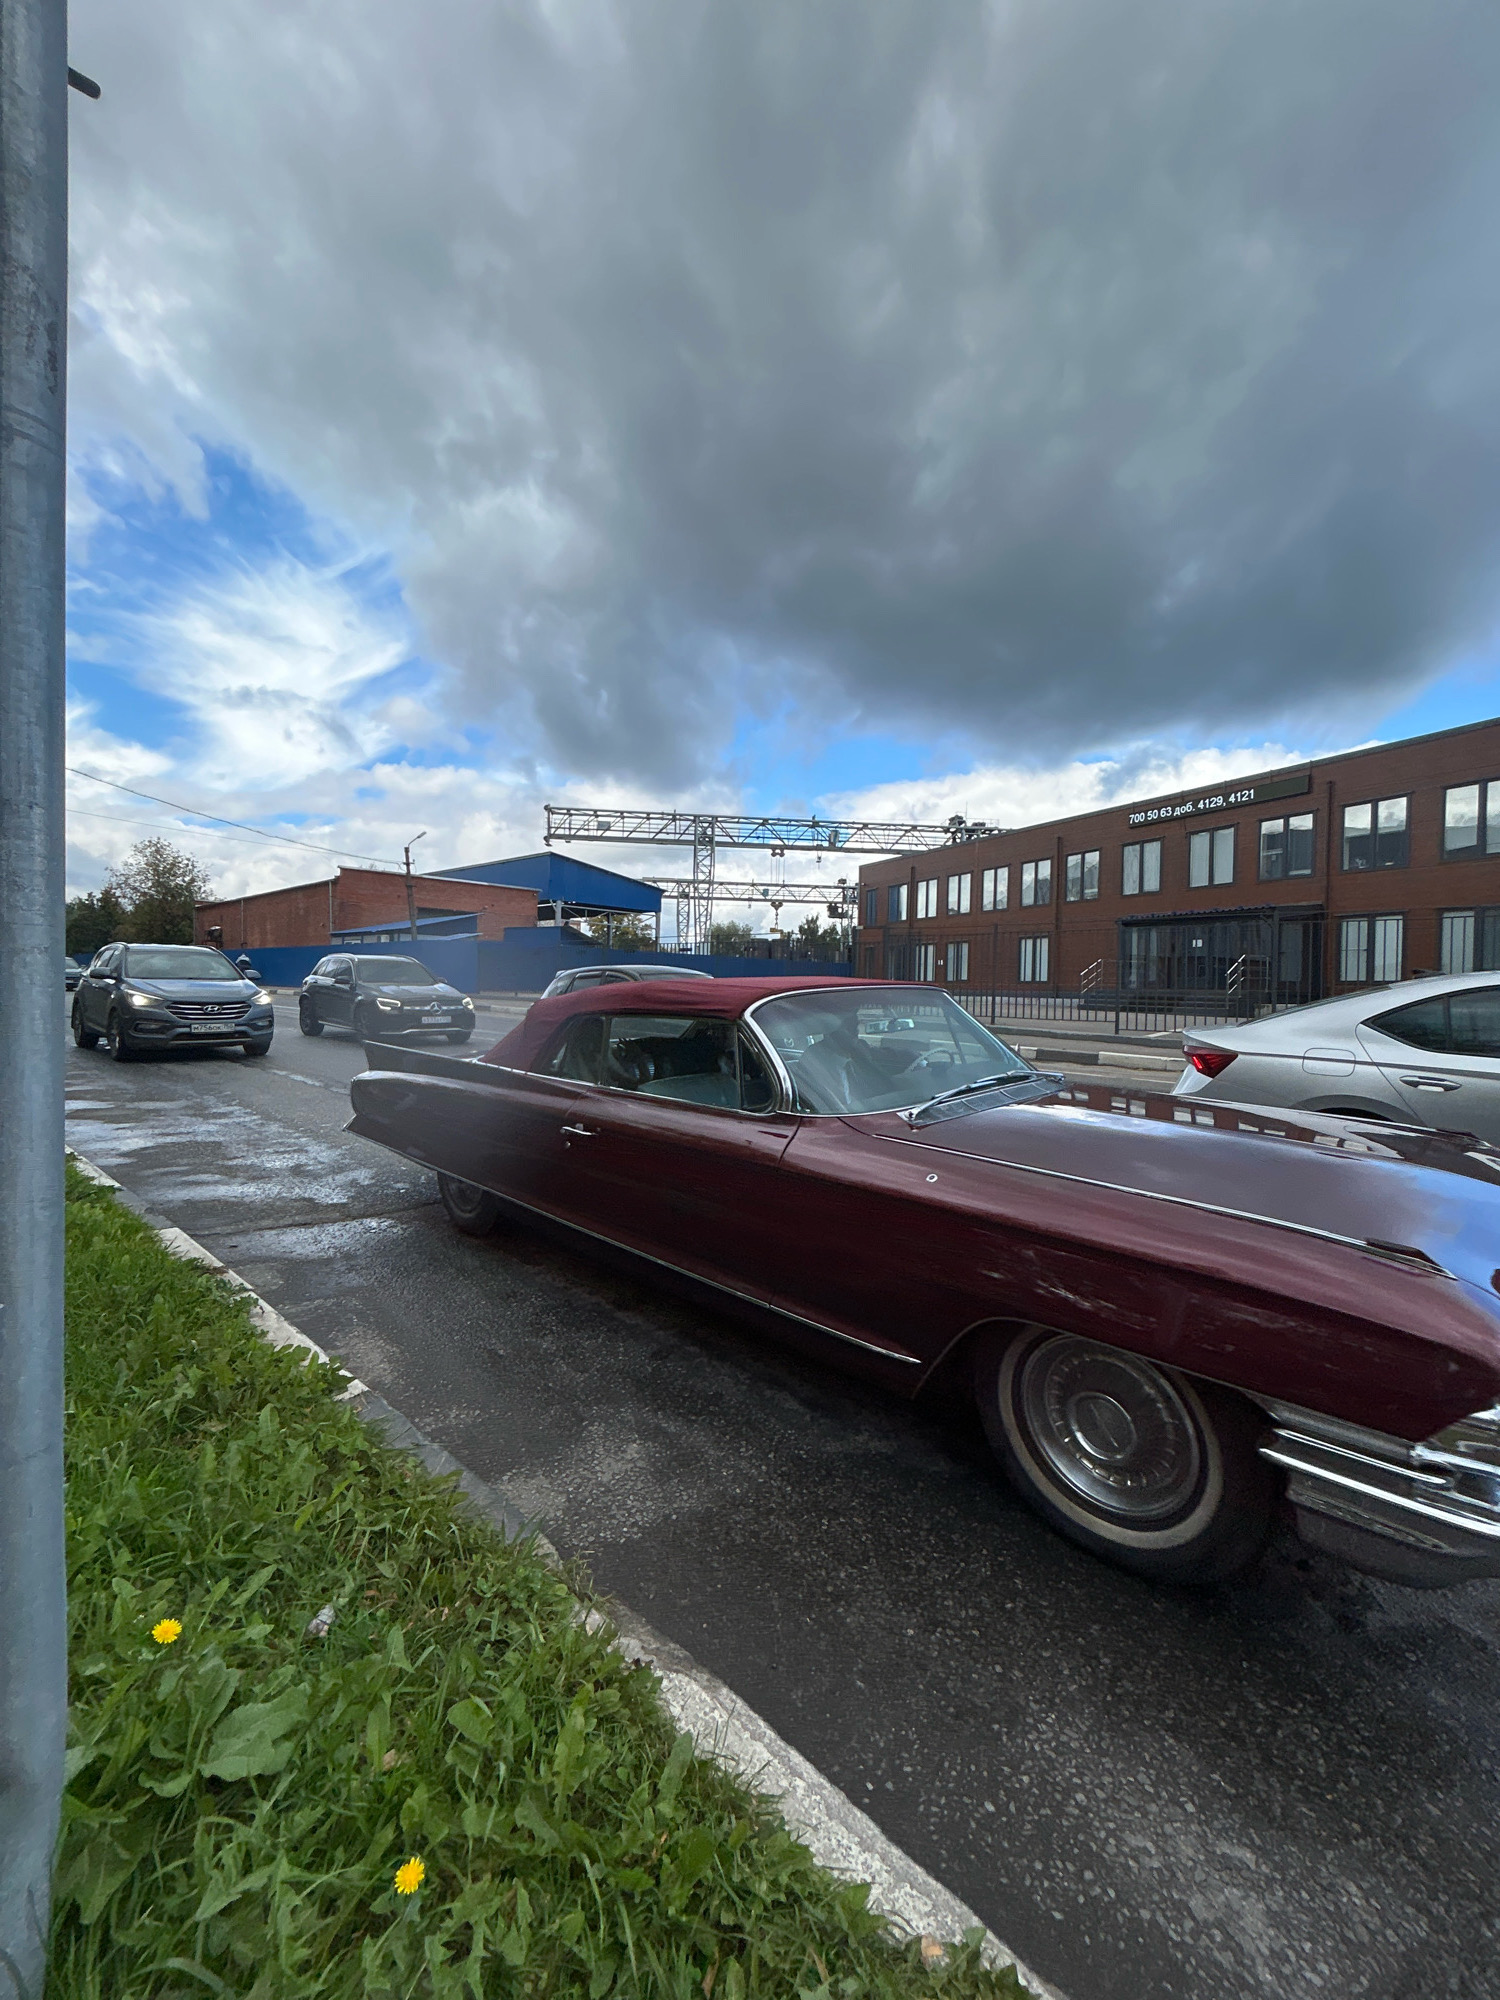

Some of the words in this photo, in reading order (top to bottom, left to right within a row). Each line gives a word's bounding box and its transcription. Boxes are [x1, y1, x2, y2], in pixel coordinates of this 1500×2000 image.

[1129, 813, 1145, 824] 700
[1147, 809, 1159, 820] 50
[1160, 807, 1172, 817] 63
[1173, 801, 1195, 816] доб.
[1198, 795, 1226, 809] 4129,
[1228, 789, 1254, 803] 4121
